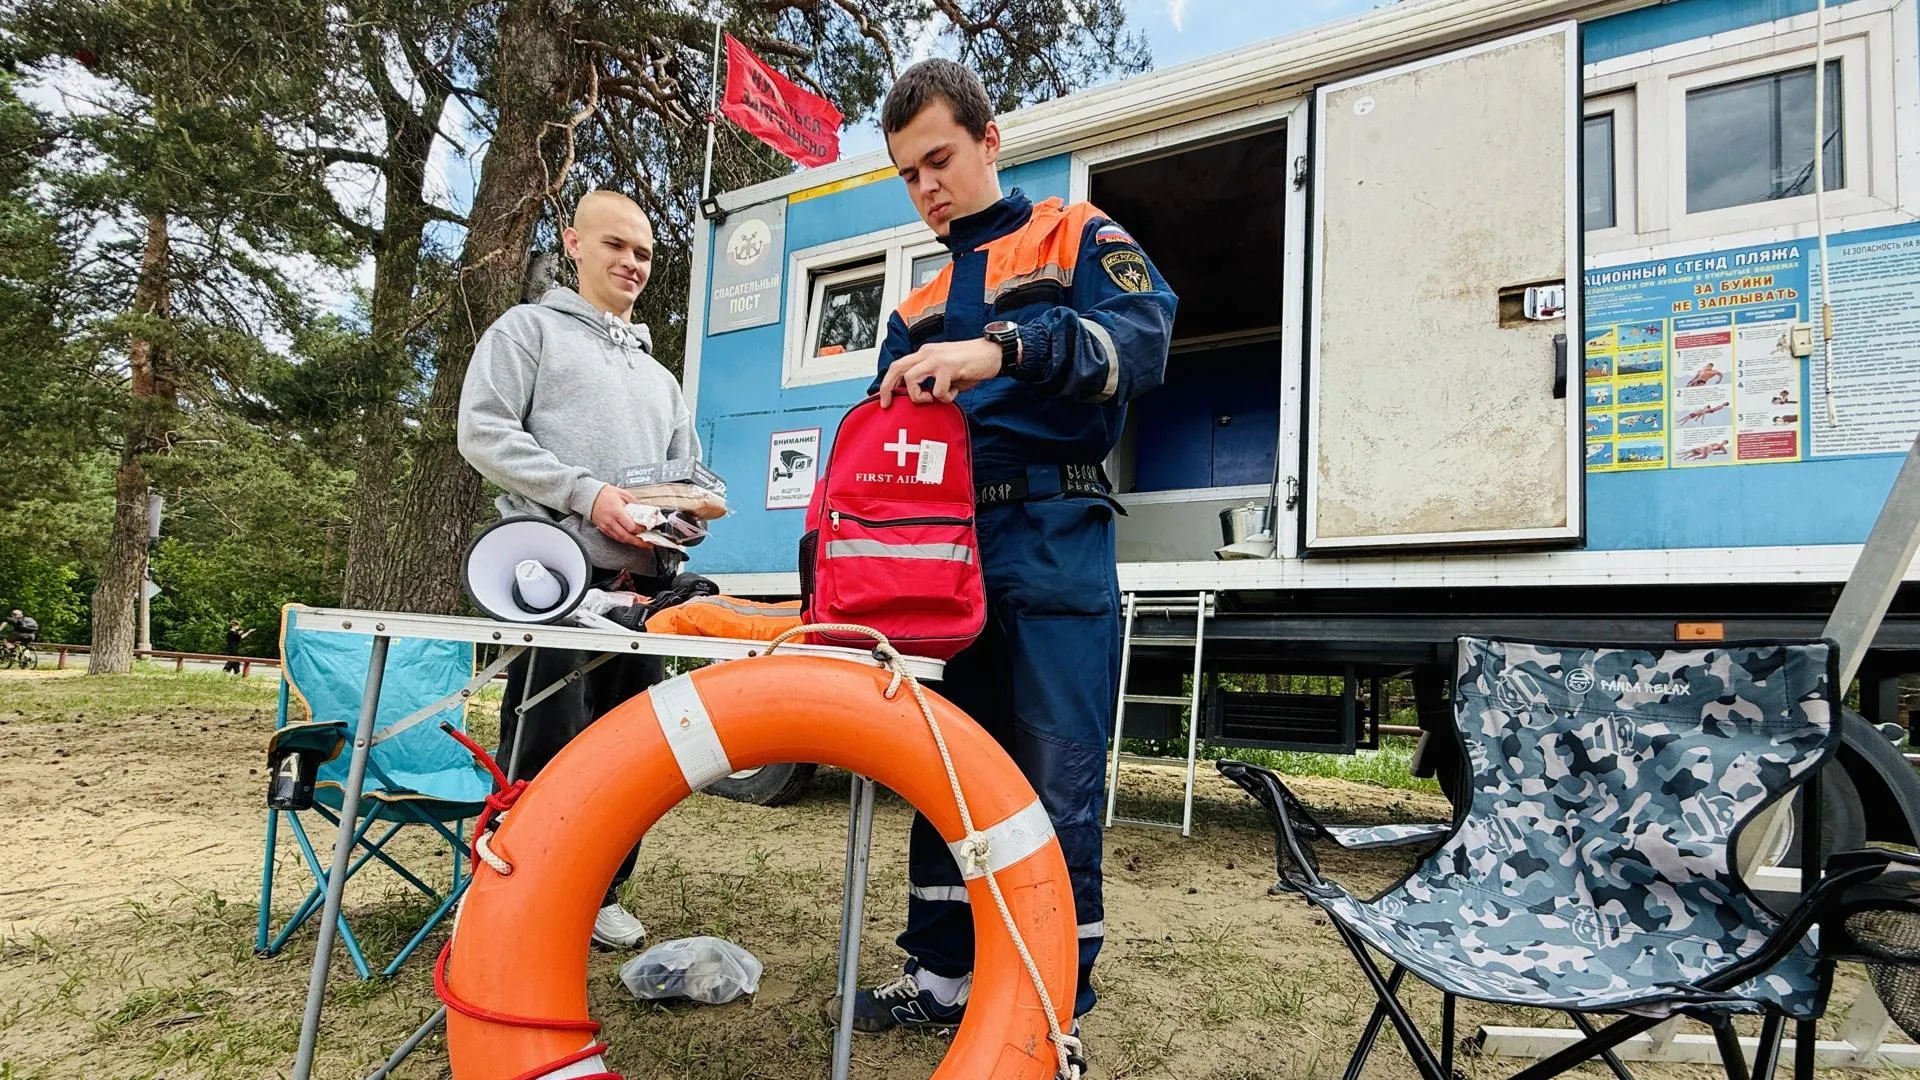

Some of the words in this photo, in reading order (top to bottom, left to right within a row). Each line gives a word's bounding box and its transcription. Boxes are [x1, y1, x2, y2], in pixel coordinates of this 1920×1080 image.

[1842, 242, 1901, 256] БЕЗОПАСНОСТЬ
[1903, 240, 1913, 248] НА
[1674, 255, 1728, 275] СТЕНД
[1735, 246, 1801, 266] ПЛЯЖА
[714, 272, 780, 300] СПАСАТЕЛЬНЫЙ
[1695, 283, 1713, 295] ЗА
[1721, 275, 1773, 291] БУЙКИ
[730, 294, 760, 313] ПОСТ
[1673, 301, 1691, 312] НЕ
[1699, 288, 1797, 309] ЗАПЛЫВАТЬ
[773, 436, 817, 446] ВНИМАНИЕ!
[855, 473, 893, 483] FIRST
[896, 475, 919, 484] AID
[1600, 679, 1641, 693] PANDA
[1644, 682, 1691, 696] RELAX
